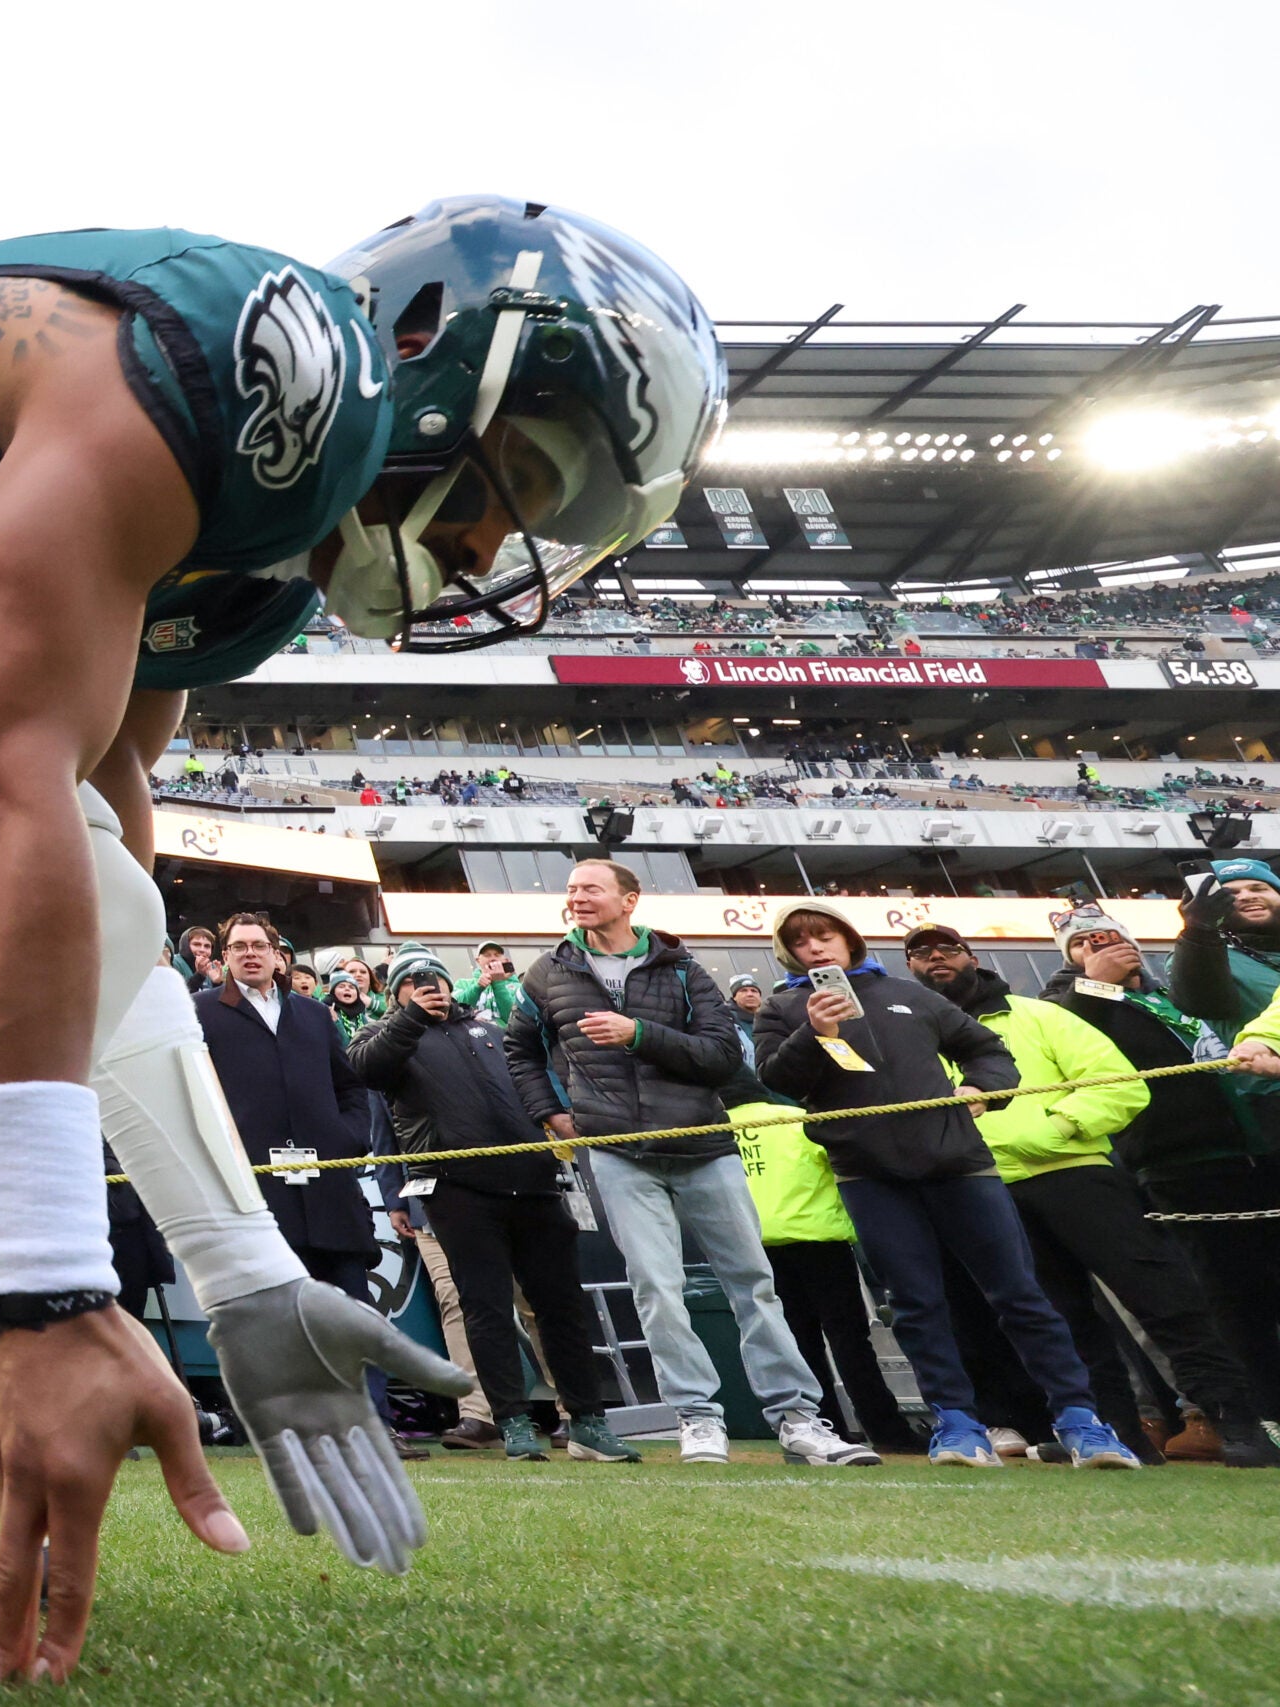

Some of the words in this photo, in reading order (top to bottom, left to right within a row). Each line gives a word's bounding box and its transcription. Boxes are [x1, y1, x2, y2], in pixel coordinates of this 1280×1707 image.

[707, 489, 750, 515] 99
[787, 489, 835, 515] 20
[724, 516, 751, 524] JEROME
[804, 522, 838, 530] DAWKINS
[152, 622, 176, 648] NFL
[714, 660, 807, 683] Lincoln
[809, 660, 923, 684] Financial
[924, 661, 987, 684] Field
[1167, 661, 1254, 685] 54:58
